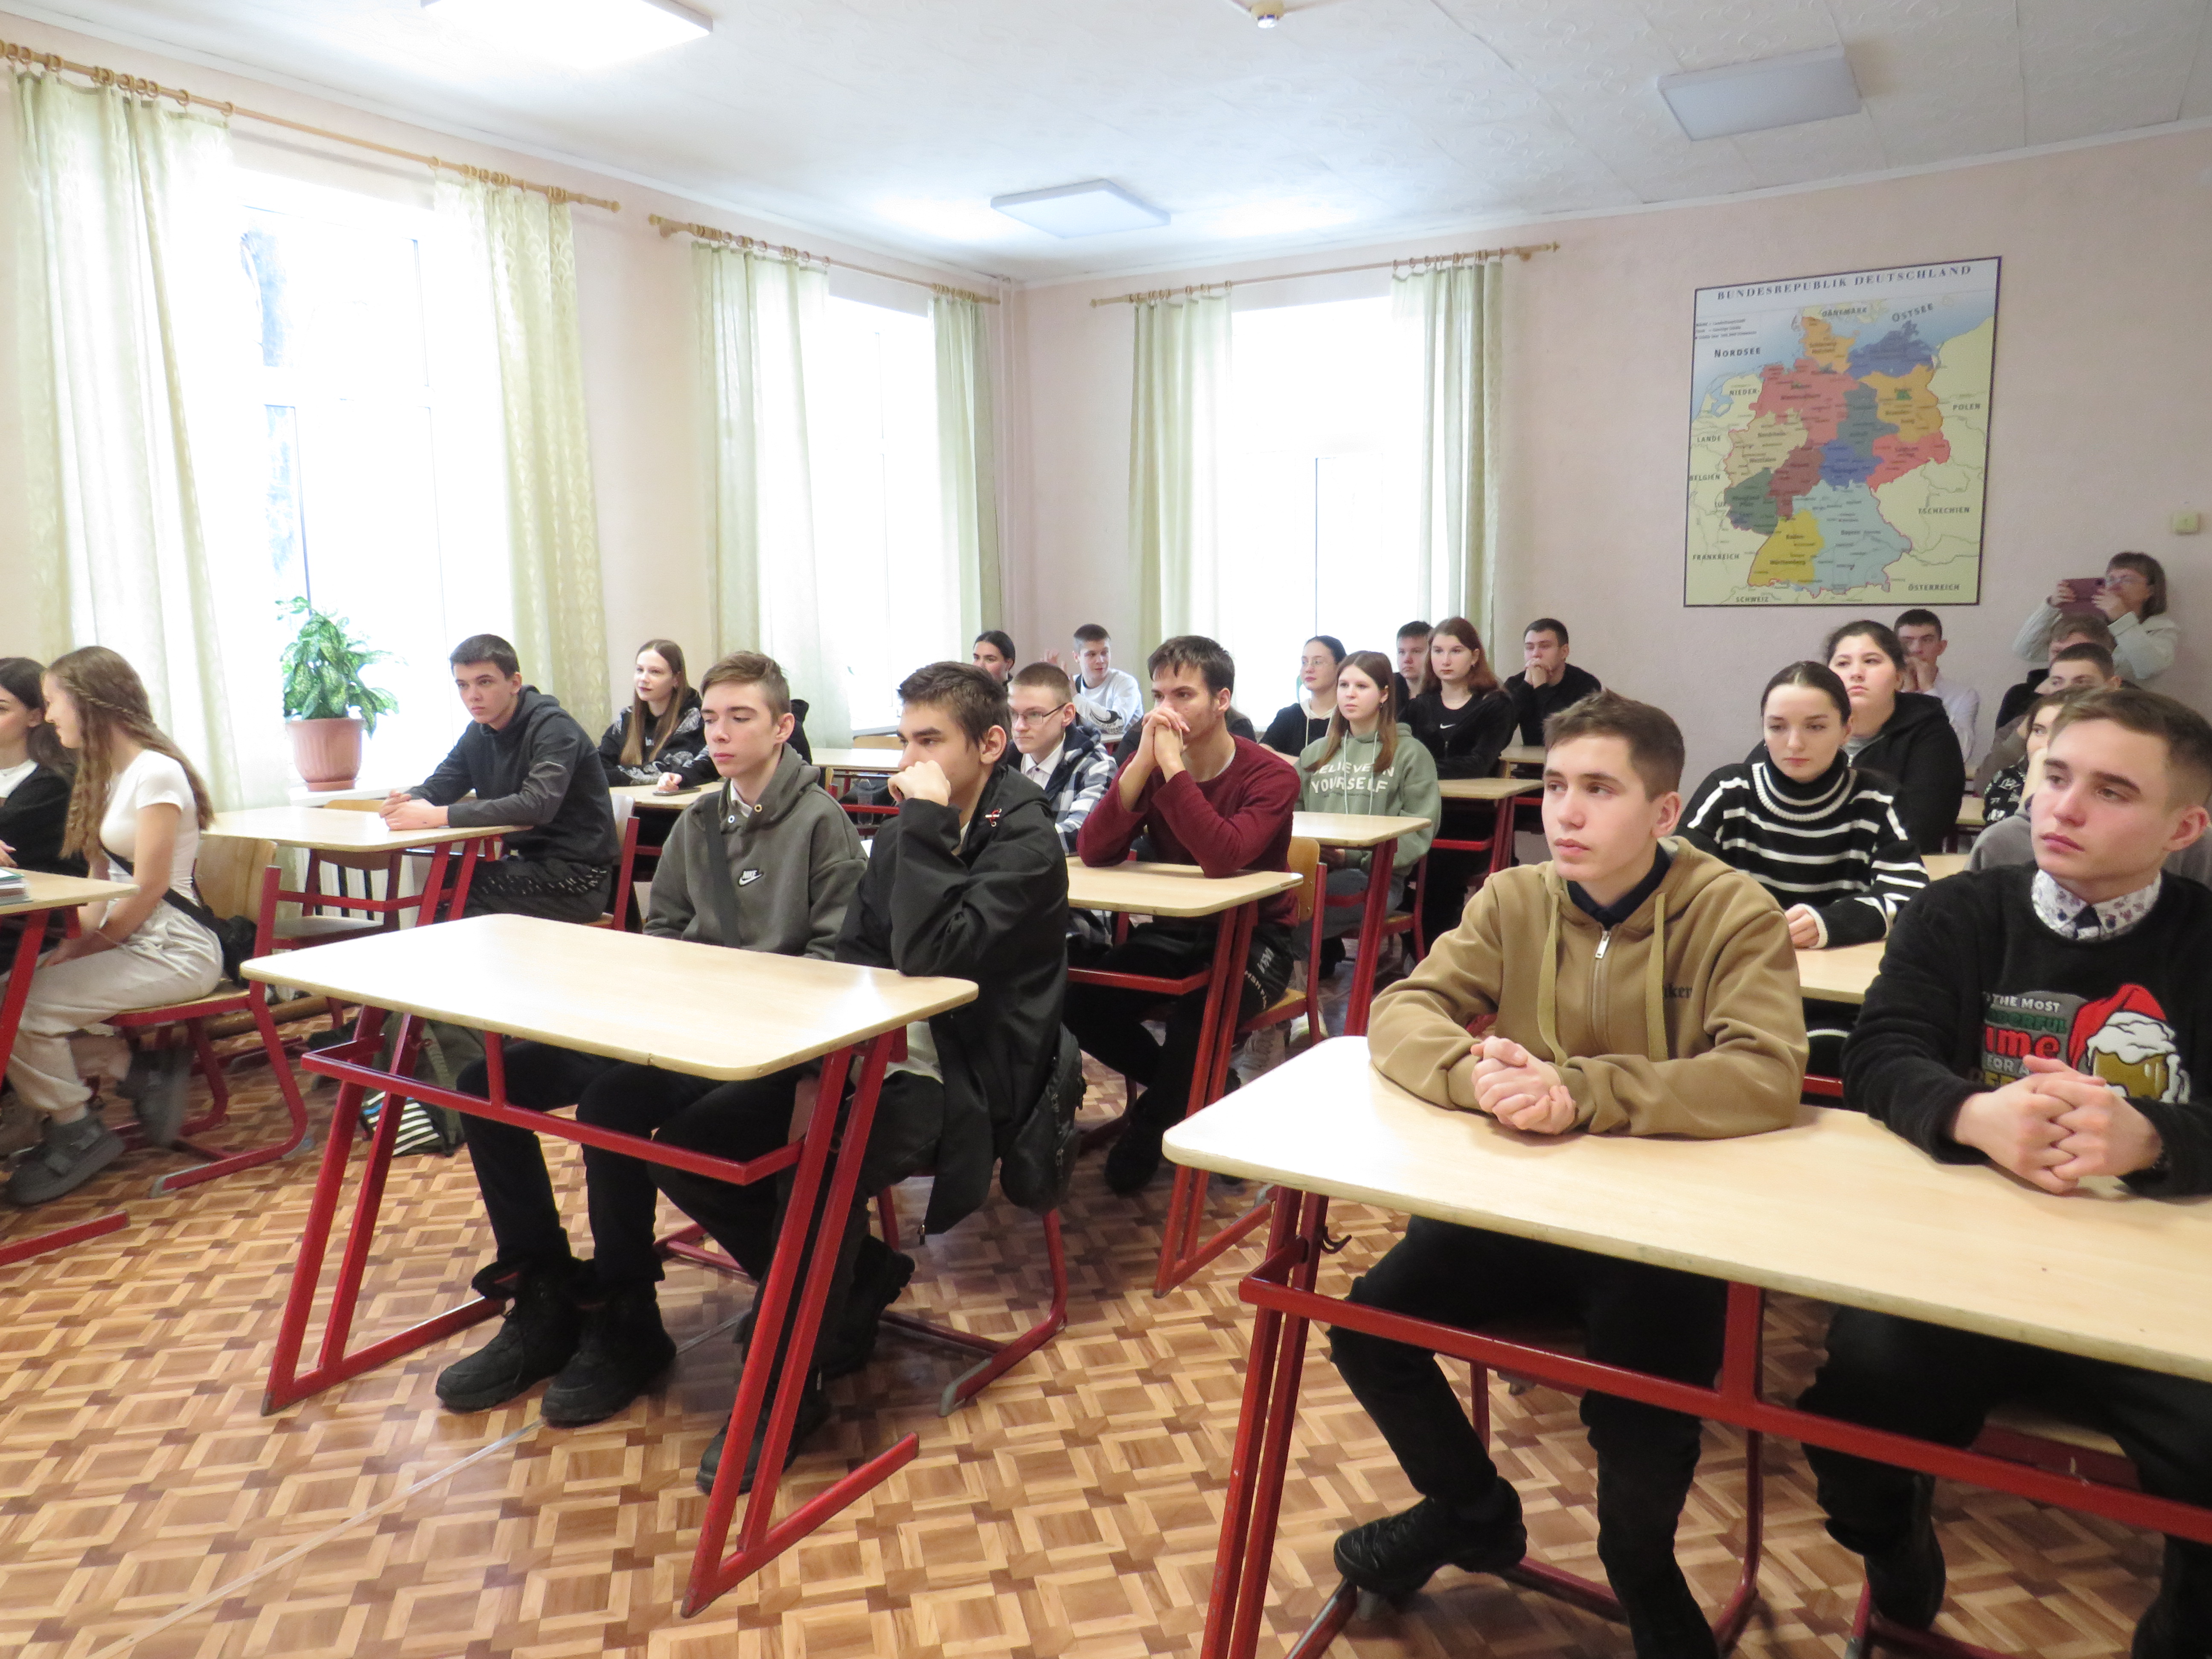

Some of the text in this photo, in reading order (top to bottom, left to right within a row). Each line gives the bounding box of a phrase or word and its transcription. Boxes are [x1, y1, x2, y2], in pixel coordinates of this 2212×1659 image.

[1717, 265, 1971, 300] BUNDESREPUBLIK DEUTSCHLAND
[1892, 303, 1934, 322] OSTSEE
[1714, 347, 1761, 358] NORDSEE
[1697, 435, 1721, 443] LANDE
[1313, 761, 1374, 776] ELIEVE
[1311, 776, 1388, 794] YOURSELF
[1992, 993, 2018, 1007] THE
[2020, 998, 2060, 1013] MOST
